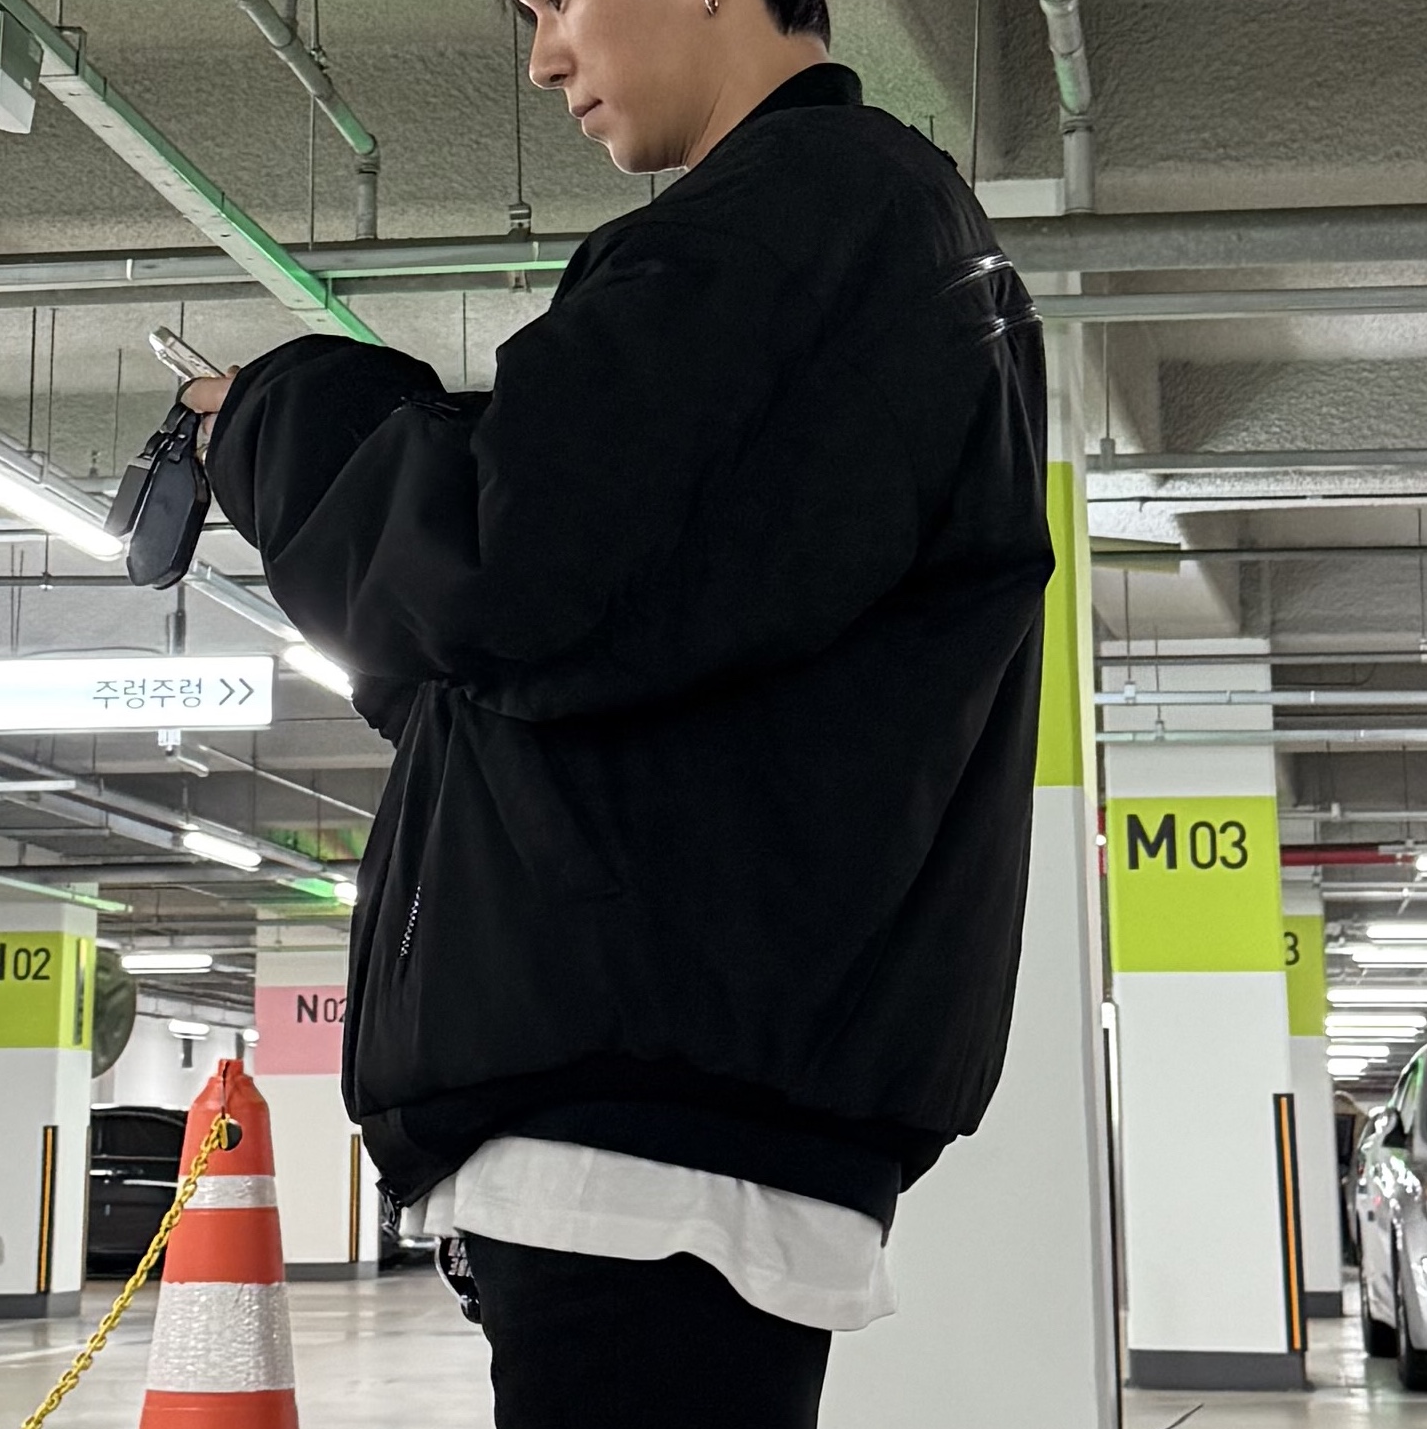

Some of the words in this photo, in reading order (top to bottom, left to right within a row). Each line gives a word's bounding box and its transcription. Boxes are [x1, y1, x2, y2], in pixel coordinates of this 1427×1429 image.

[92, 678, 203, 710] 주렁주렁
[1126, 813, 1177, 870] M
[1189, 820, 1248, 870] 03
[13, 947, 51, 981] 02
[297, 994, 318, 1023] N
